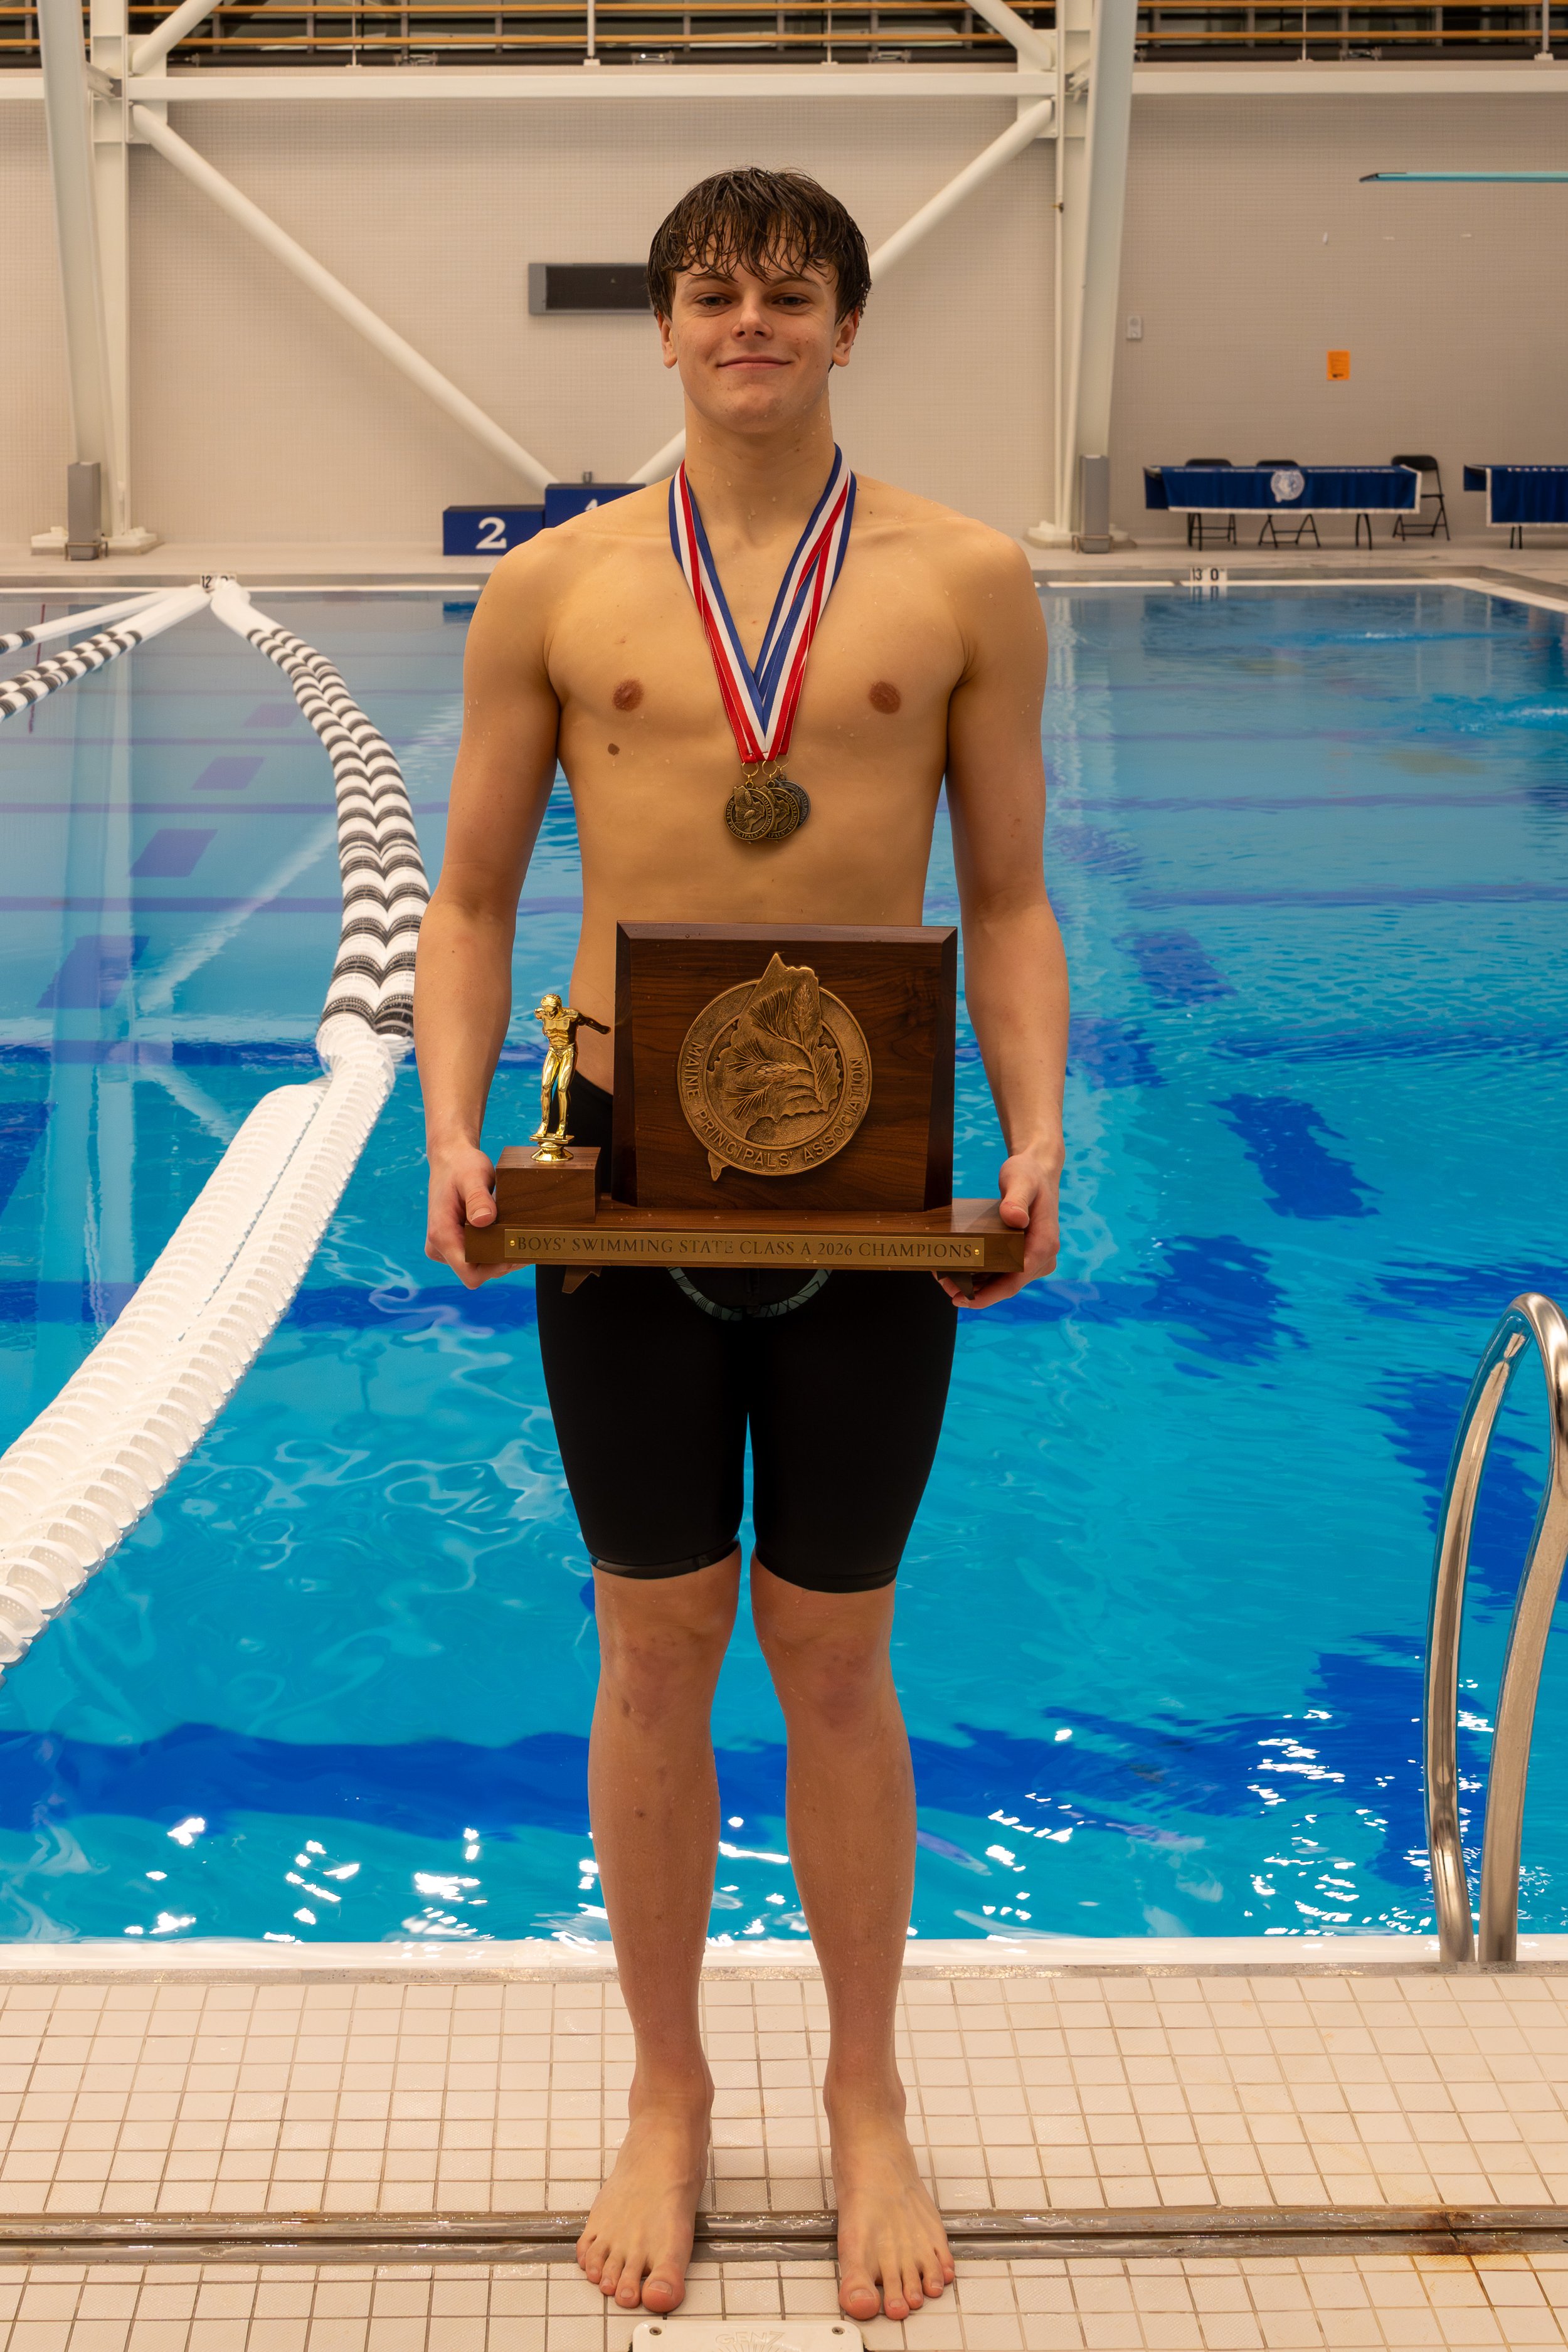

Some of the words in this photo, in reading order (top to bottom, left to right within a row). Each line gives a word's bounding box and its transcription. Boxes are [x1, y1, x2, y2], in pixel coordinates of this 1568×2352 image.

[475, 517, 507, 549] 2
[686, 1042, 705, 1100] MAINE
[804, 1056, 863, 1162] ASSOCIATION
[695, 1110, 793, 1167] PRINCIPALS'
[517, 1236, 566, 1252] BOYS'
[571, 1238, 672, 1253] SWIMMING
[679, 1240, 734, 1254] STATE
[740, 1241, 794, 1255] CLASS
[801, 1242, 812, 1255] A
[817, 1242, 853, 1256] 2026
[859, 1242, 972, 1259] CHAMPIONS
